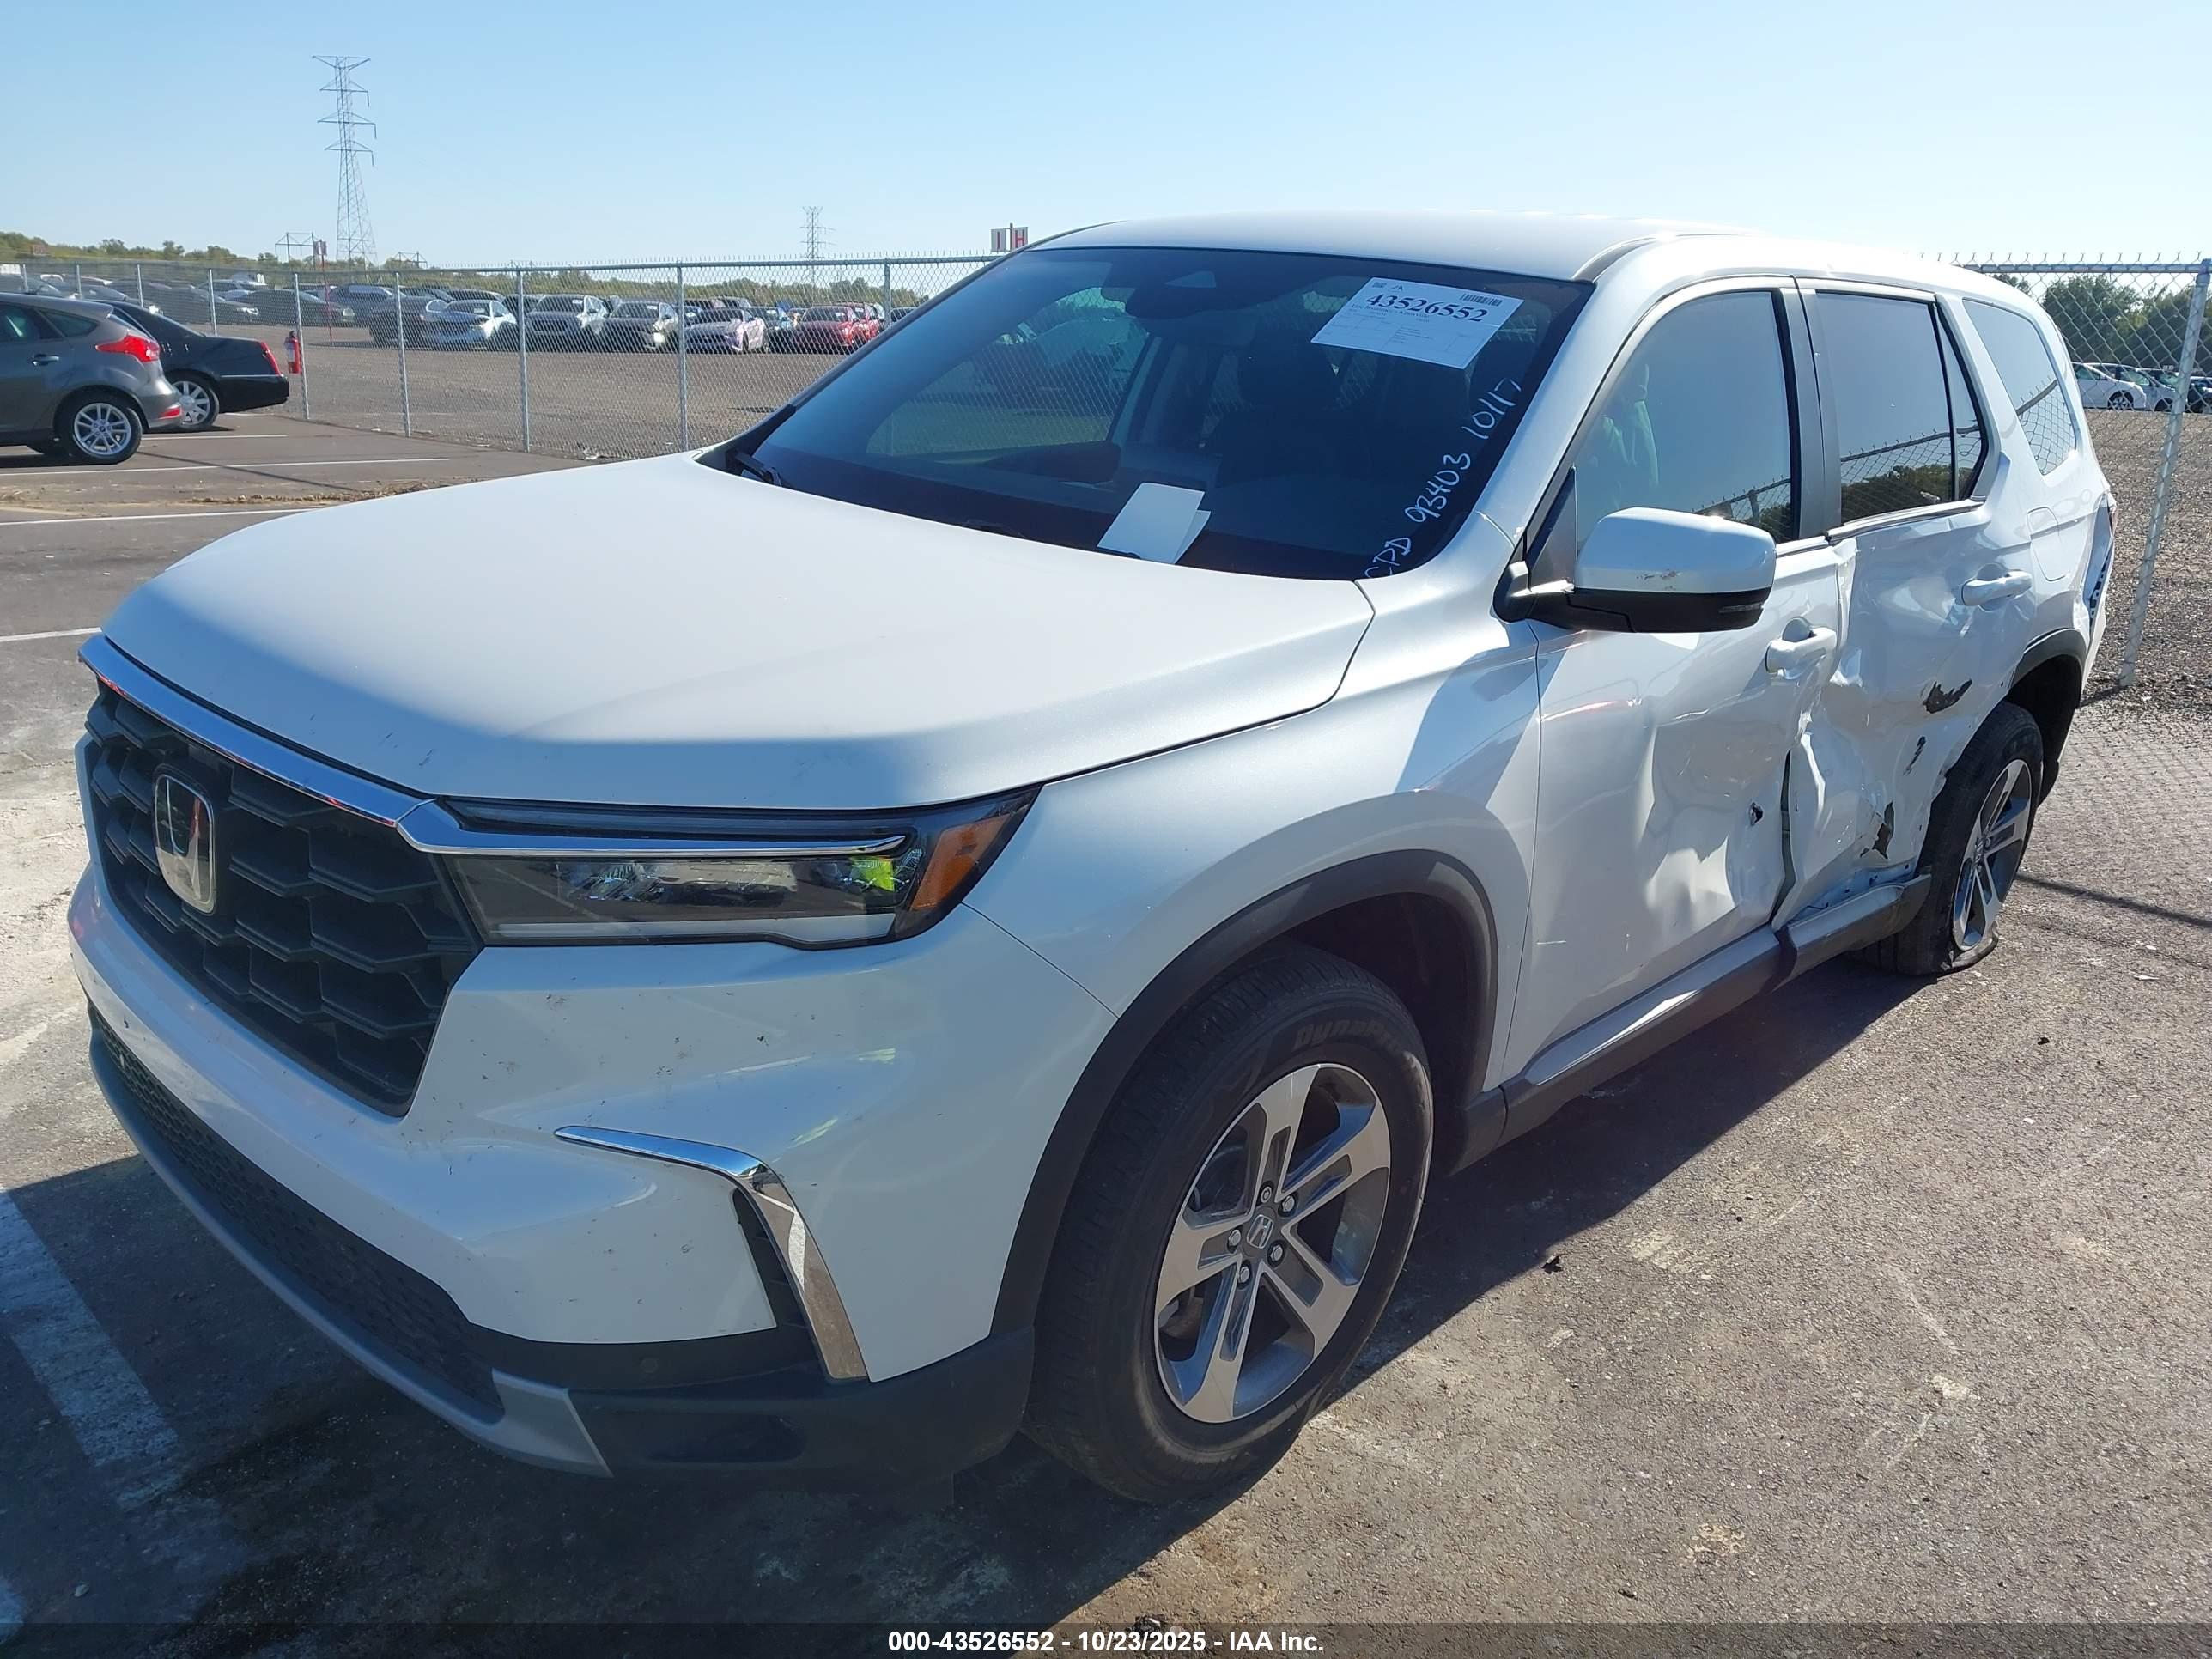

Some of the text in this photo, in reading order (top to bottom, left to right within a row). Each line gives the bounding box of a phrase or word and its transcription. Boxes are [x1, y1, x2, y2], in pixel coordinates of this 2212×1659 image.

[1014, 229, 1025, 248] H
[1365, 293, 1489, 323] 43526552
[1404, 453, 1471, 523] 93403
